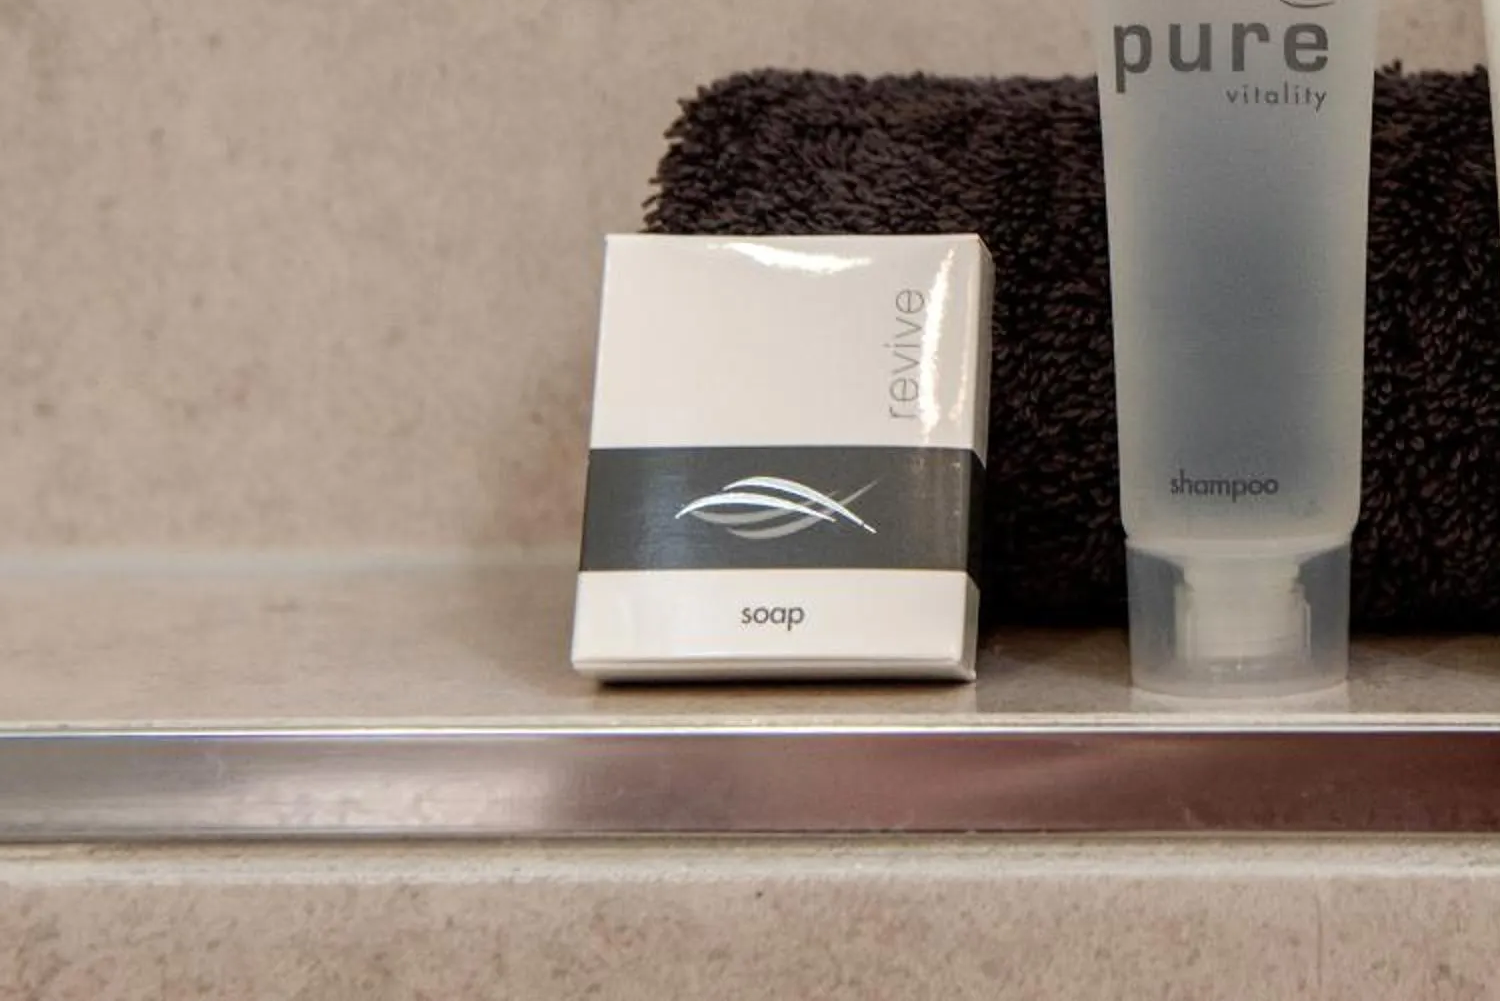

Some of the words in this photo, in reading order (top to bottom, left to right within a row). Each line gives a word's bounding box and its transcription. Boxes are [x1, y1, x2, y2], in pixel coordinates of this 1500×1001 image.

[1226, 81, 1328, 112] vitality
[883, 288, 926, 421] revive
[1170, 469, 1279, 503] shampoo
[741, 603, 805, 631] soap
